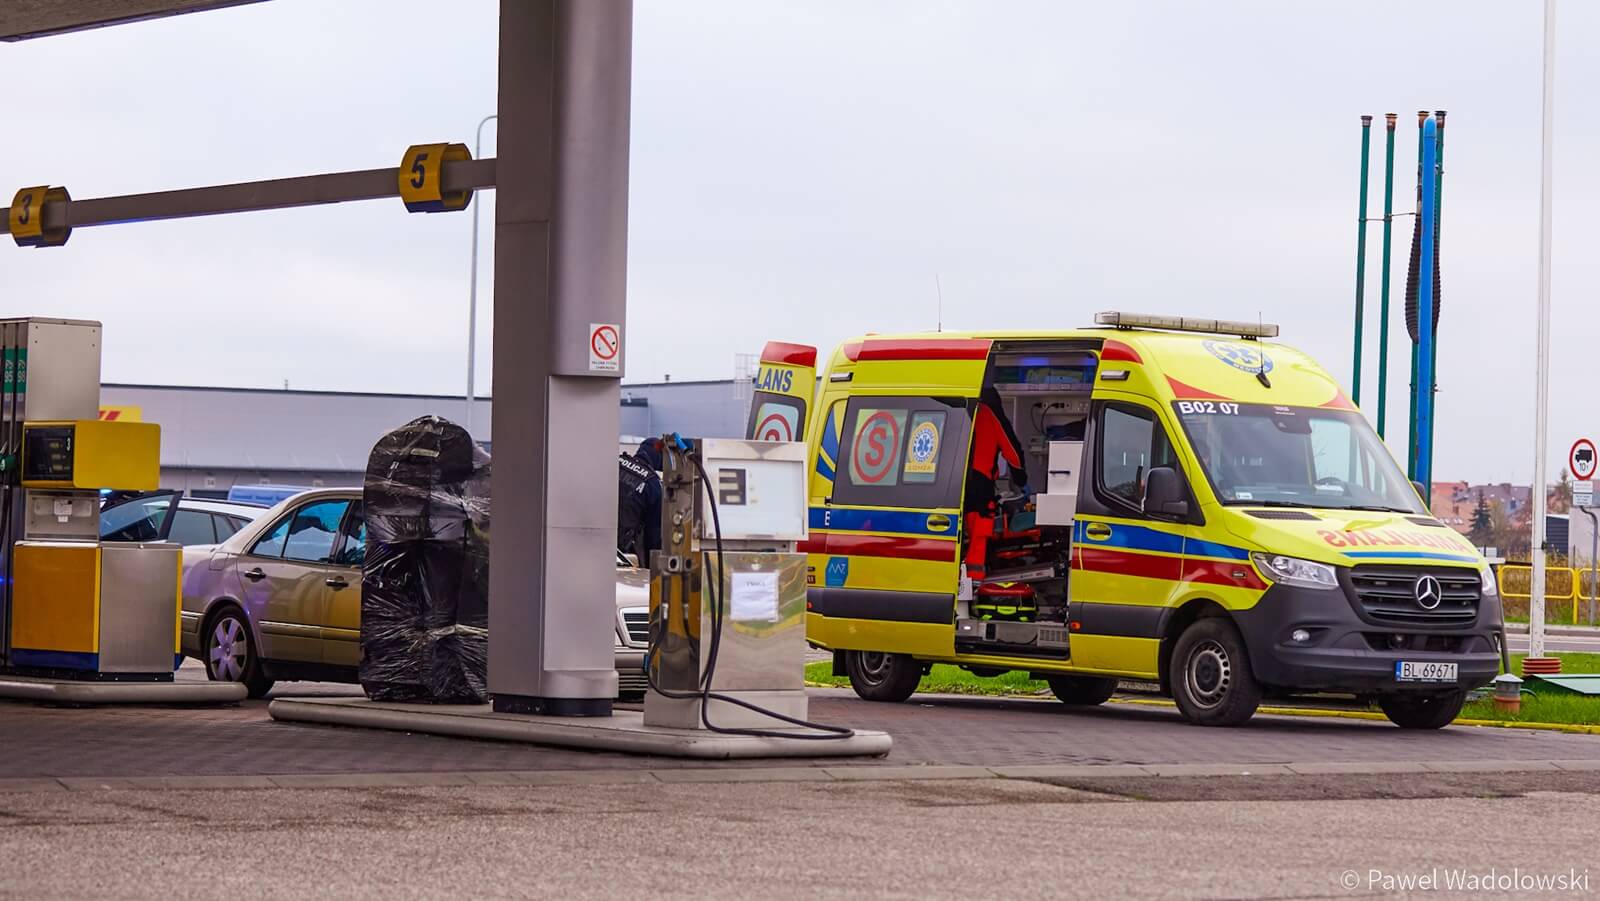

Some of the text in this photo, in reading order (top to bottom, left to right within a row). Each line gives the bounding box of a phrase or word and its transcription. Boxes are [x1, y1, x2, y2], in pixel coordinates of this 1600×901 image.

[410, 153, 428, 189] 5
[18, 193, 32, 225] 3
[754, 367, 793, 393] LANS
[1178, 401, 1240, 416] B02 07
[864, 426, 888, 468] S
[1404, 663, 1455, 678] BL 69671
